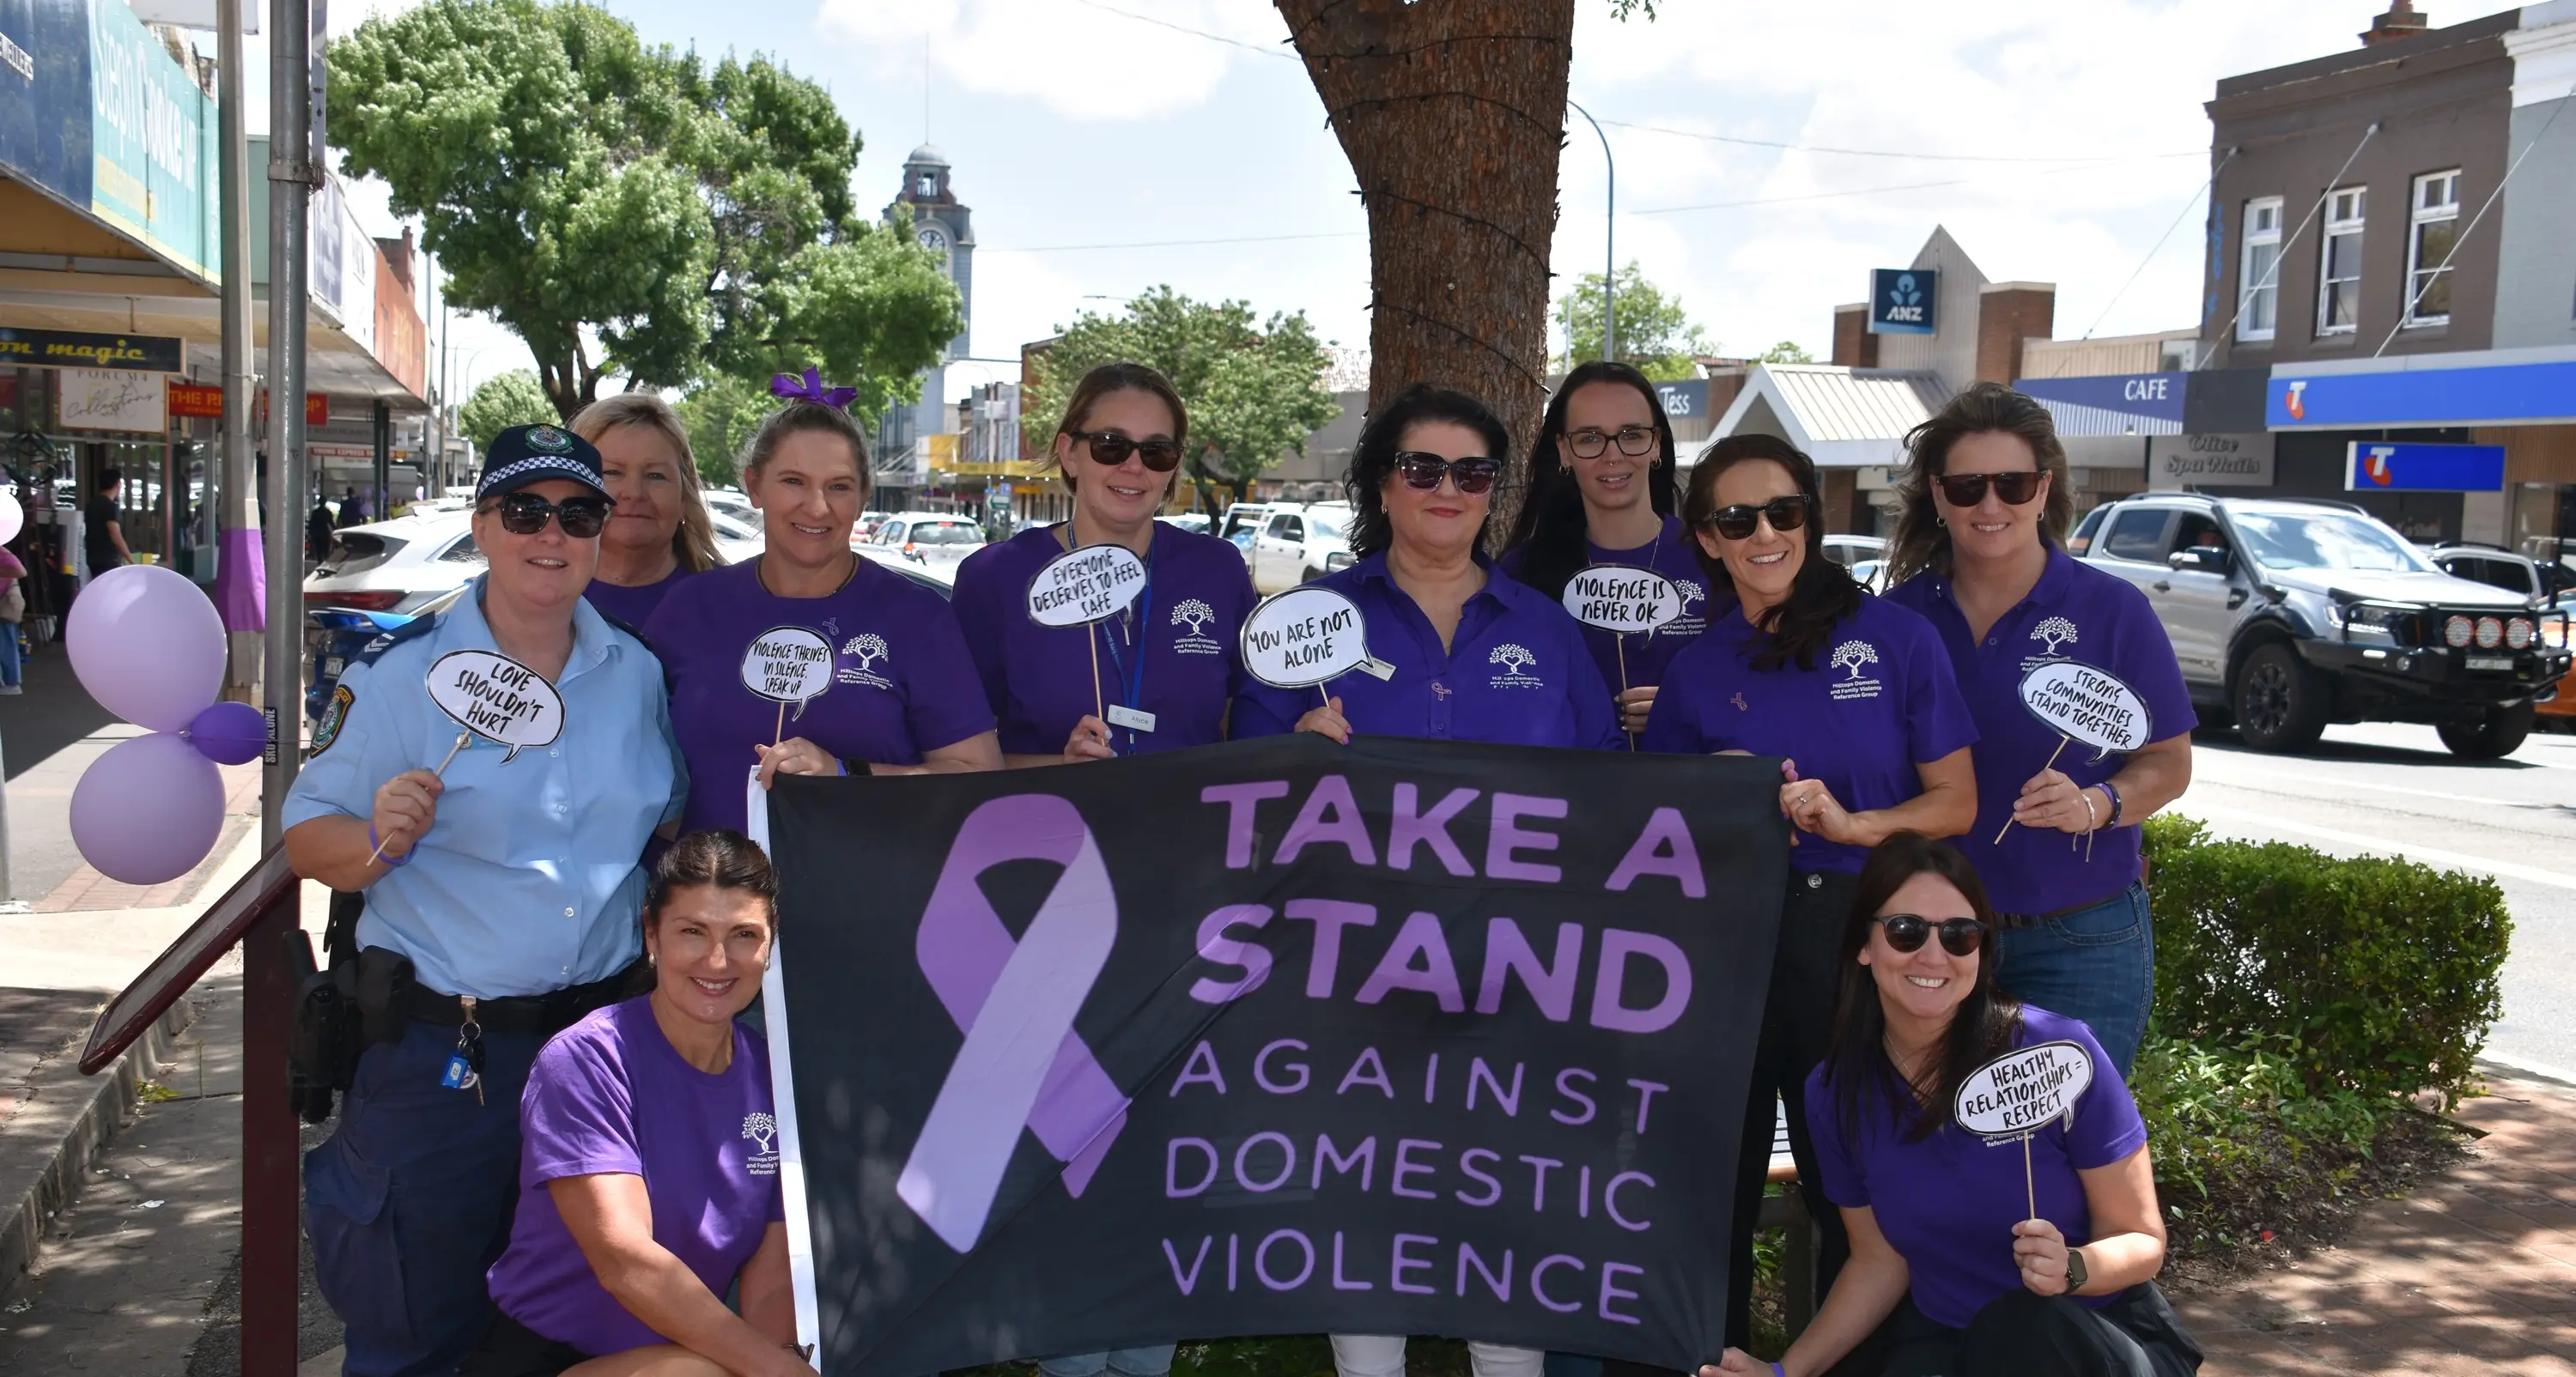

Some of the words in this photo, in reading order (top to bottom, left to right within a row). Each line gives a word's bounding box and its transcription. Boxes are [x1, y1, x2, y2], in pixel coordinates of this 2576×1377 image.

[1886, 306, 1923, 321] ANZ
[46, 339, 146, 365] magic
[171, 391, 201, 405] THE
[1659, 386, 1690, 416] Tess
[2124, 379, 2168, 401] CAFE
[2189, 436, 2239, 452] Olive
[2165, 455, 2204, 476] Spa
[2207, 457, 2260, 473] Nails
[1096, 572, 1112, 589] TO
[1113, 561, 1140, 585] FEEL
[1653, 580, 1665, 599] IS
[1081, 591, 1111, 617] SAFE
[1636, 602, 1659, 624] OK
[1249, 630, 1280, 652] YOU
[1287, 617, 1315, 644] ARE
[794, 645, 829, 663] THRIVES
[490, 663, 536, 692] LOVE
[763, 678, 787, 695] SPEAK
[790, 681, 802, 695] UP
[871, 681, 887, 689] Group
[466, 700, 513, 735] HURT
[2072, 708, 2132, 749] TOGETHER
[1200, 774, 1570, 884] TAKE
[1604, 807, 1707, 899] A
[1188, 898, 1693, 1034] STAND
[1990, 1048, 2055, 1088] HEALTHY
[1169, 1039, 1670, 1135] AGAINST
[2002, 1089, 2061, 1129] RESPECT
[1986, 1137, 2015, 1148] Reference
[1164, 1131, 1656, 1232] DOMESTIC
[1162, 1228, 1645, 1325] VIOLENCE
